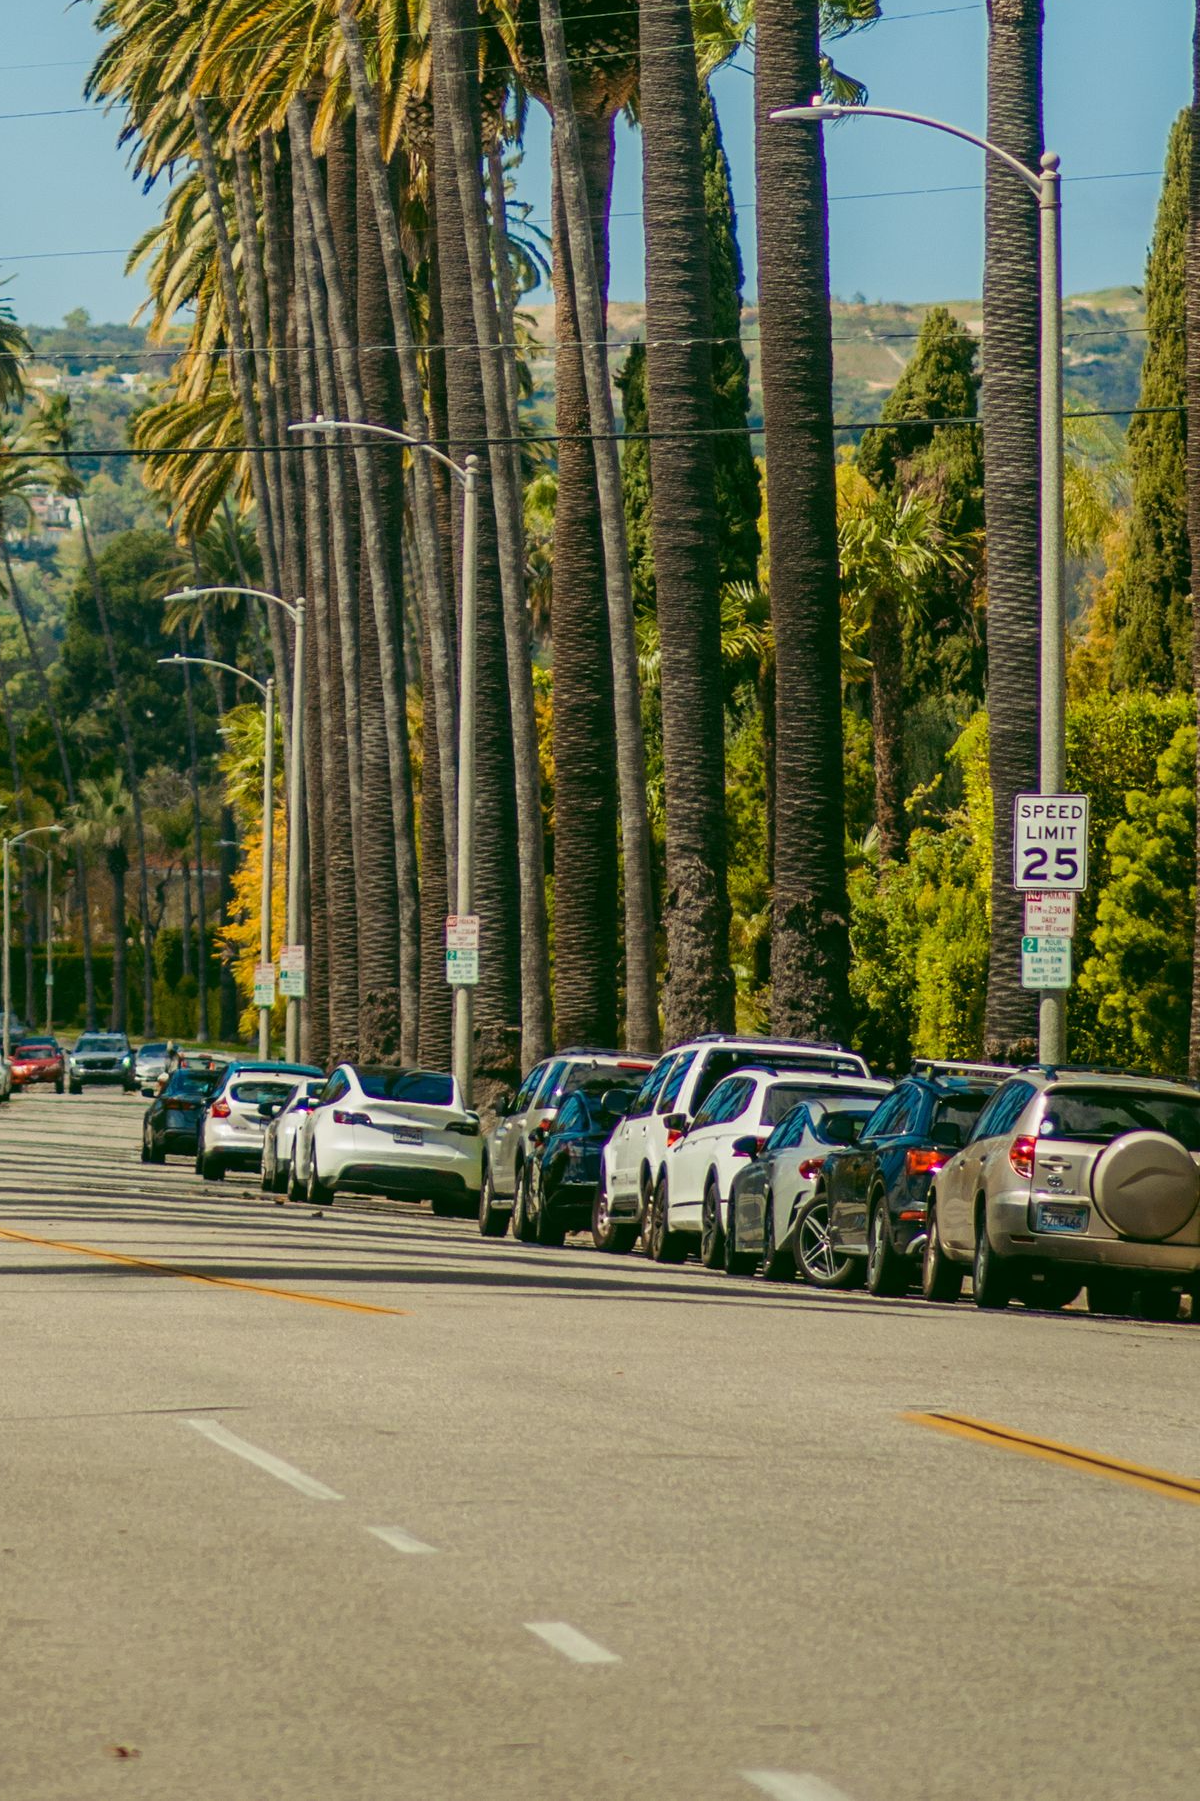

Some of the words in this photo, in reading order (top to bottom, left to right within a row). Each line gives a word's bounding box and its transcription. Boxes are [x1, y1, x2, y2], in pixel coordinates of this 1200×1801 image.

[1021, 805, 1083, 818] SPEED
[1026, 826, 1077, 839] LIMIT
[1022, 847, 1078, 880] 25
[1041, 916, 1057, 924] DAILY
[1027, 939, 1035, 952] 2
